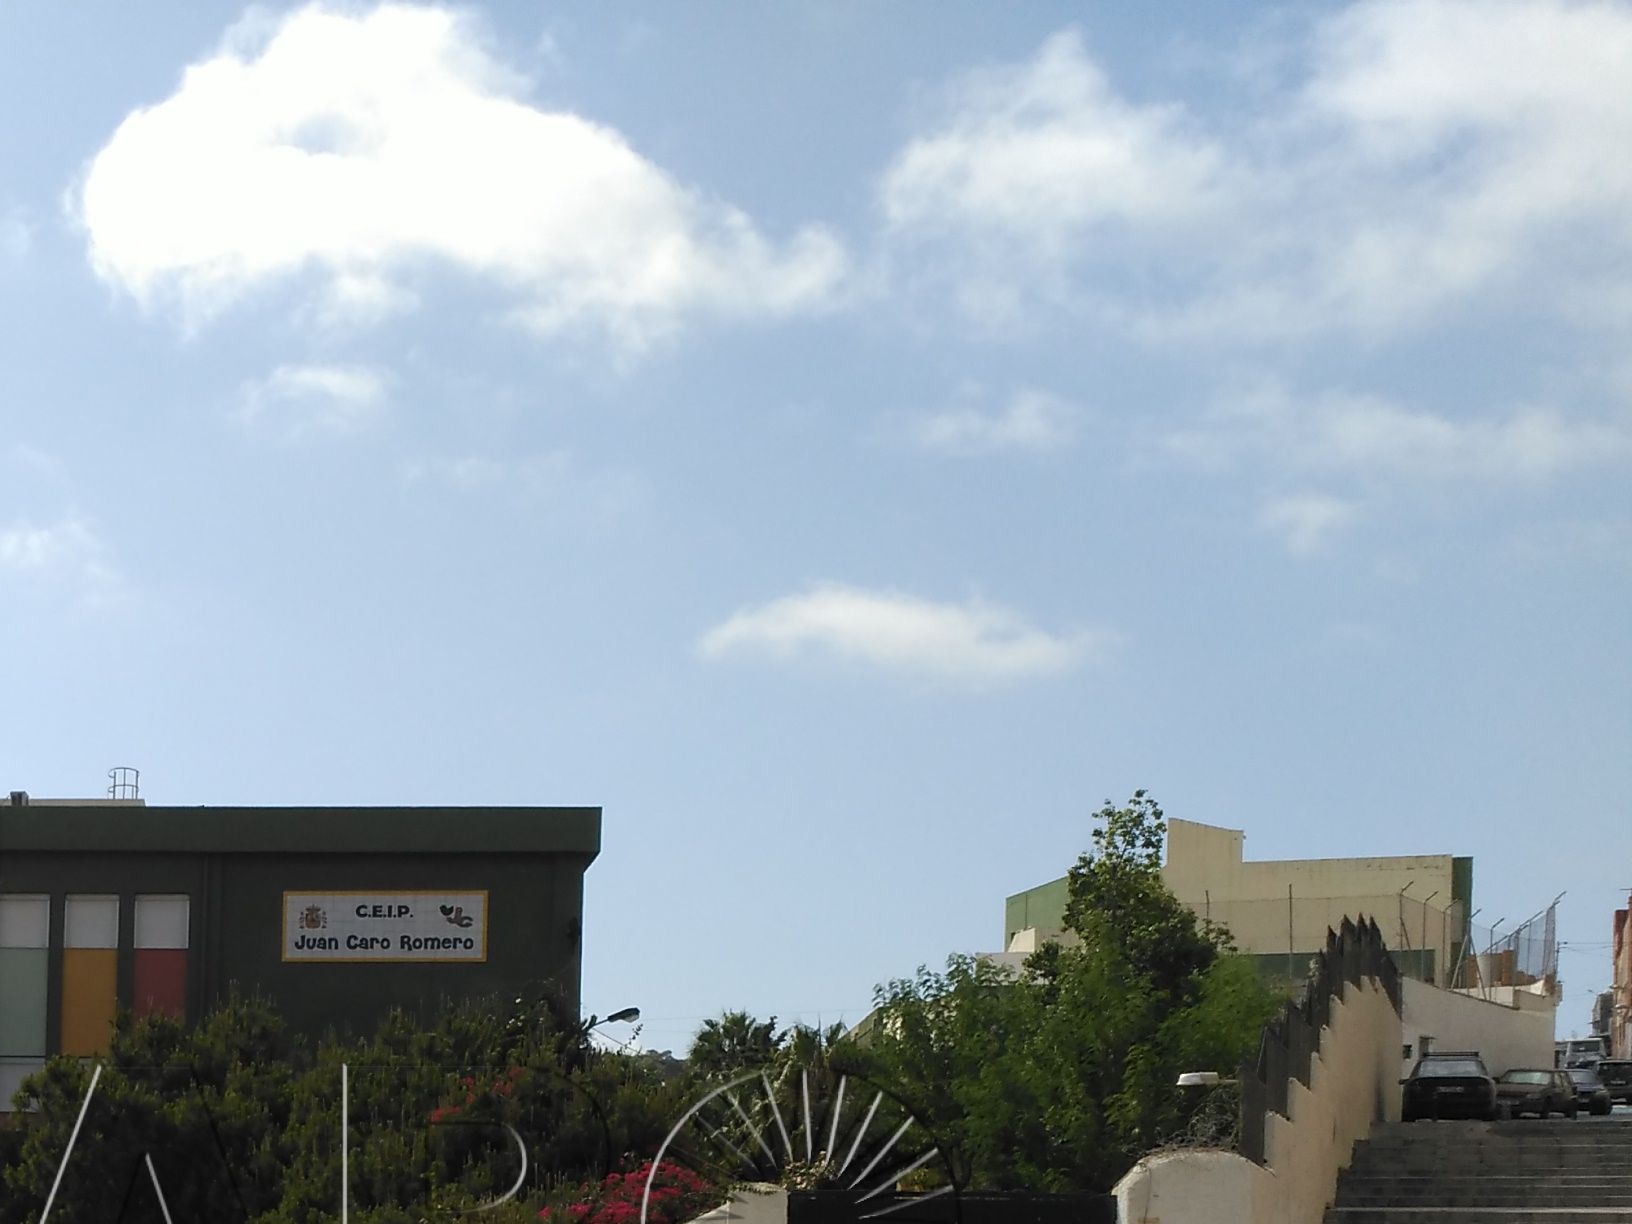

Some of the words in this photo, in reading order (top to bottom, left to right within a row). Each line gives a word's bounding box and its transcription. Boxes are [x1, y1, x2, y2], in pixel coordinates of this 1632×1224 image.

[355, 904, 414, 919] C.E.I.P.
[294, 934, 339, 951] Juan
[346, 934, 391, 951] Caro
[400, 934, 474, 951] Romero
